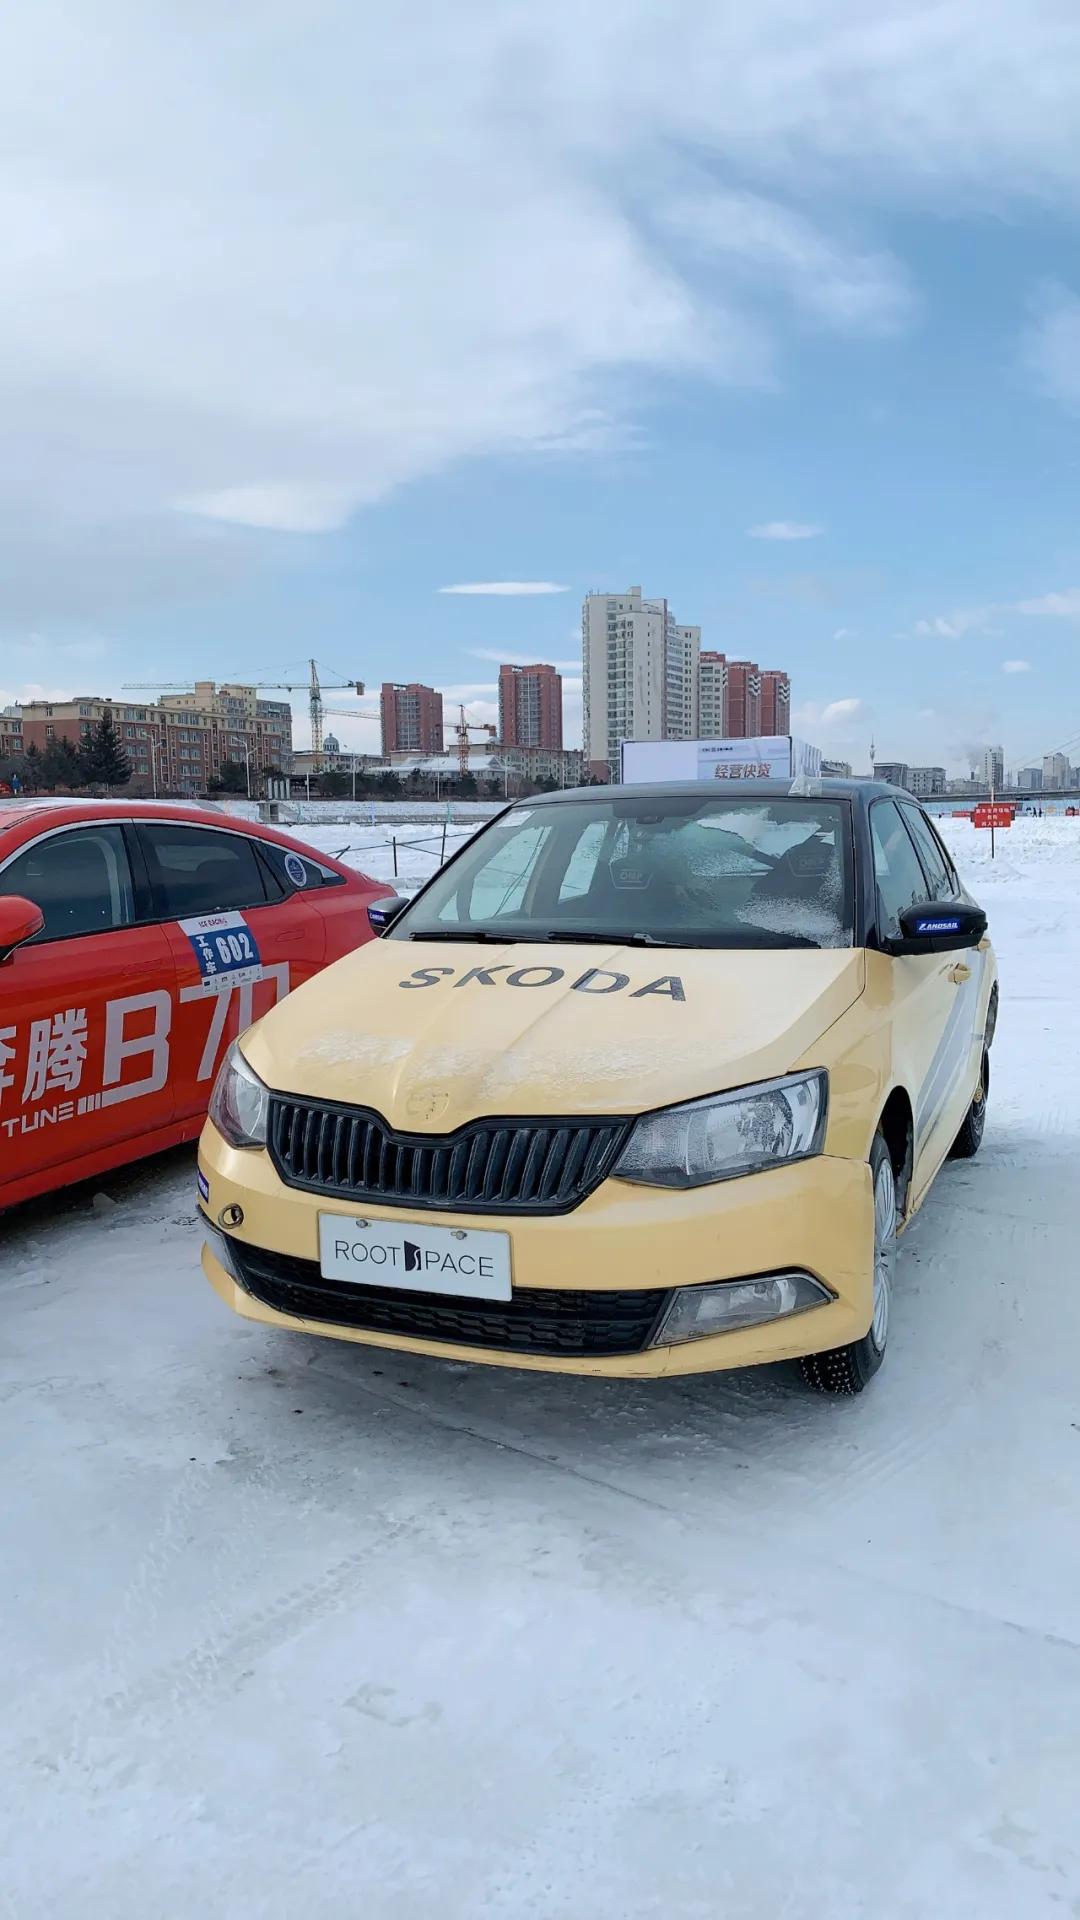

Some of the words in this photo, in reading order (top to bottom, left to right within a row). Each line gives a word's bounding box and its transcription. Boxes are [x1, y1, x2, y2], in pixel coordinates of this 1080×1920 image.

[714, 763, 771, 779] 经营快贷
[196, 935, 217, 974] 工作车
[216, 933, 254, 964] 602
[398, 965, 686, 1002] SKODA
[0, 1007, 88, 1105] 腾
